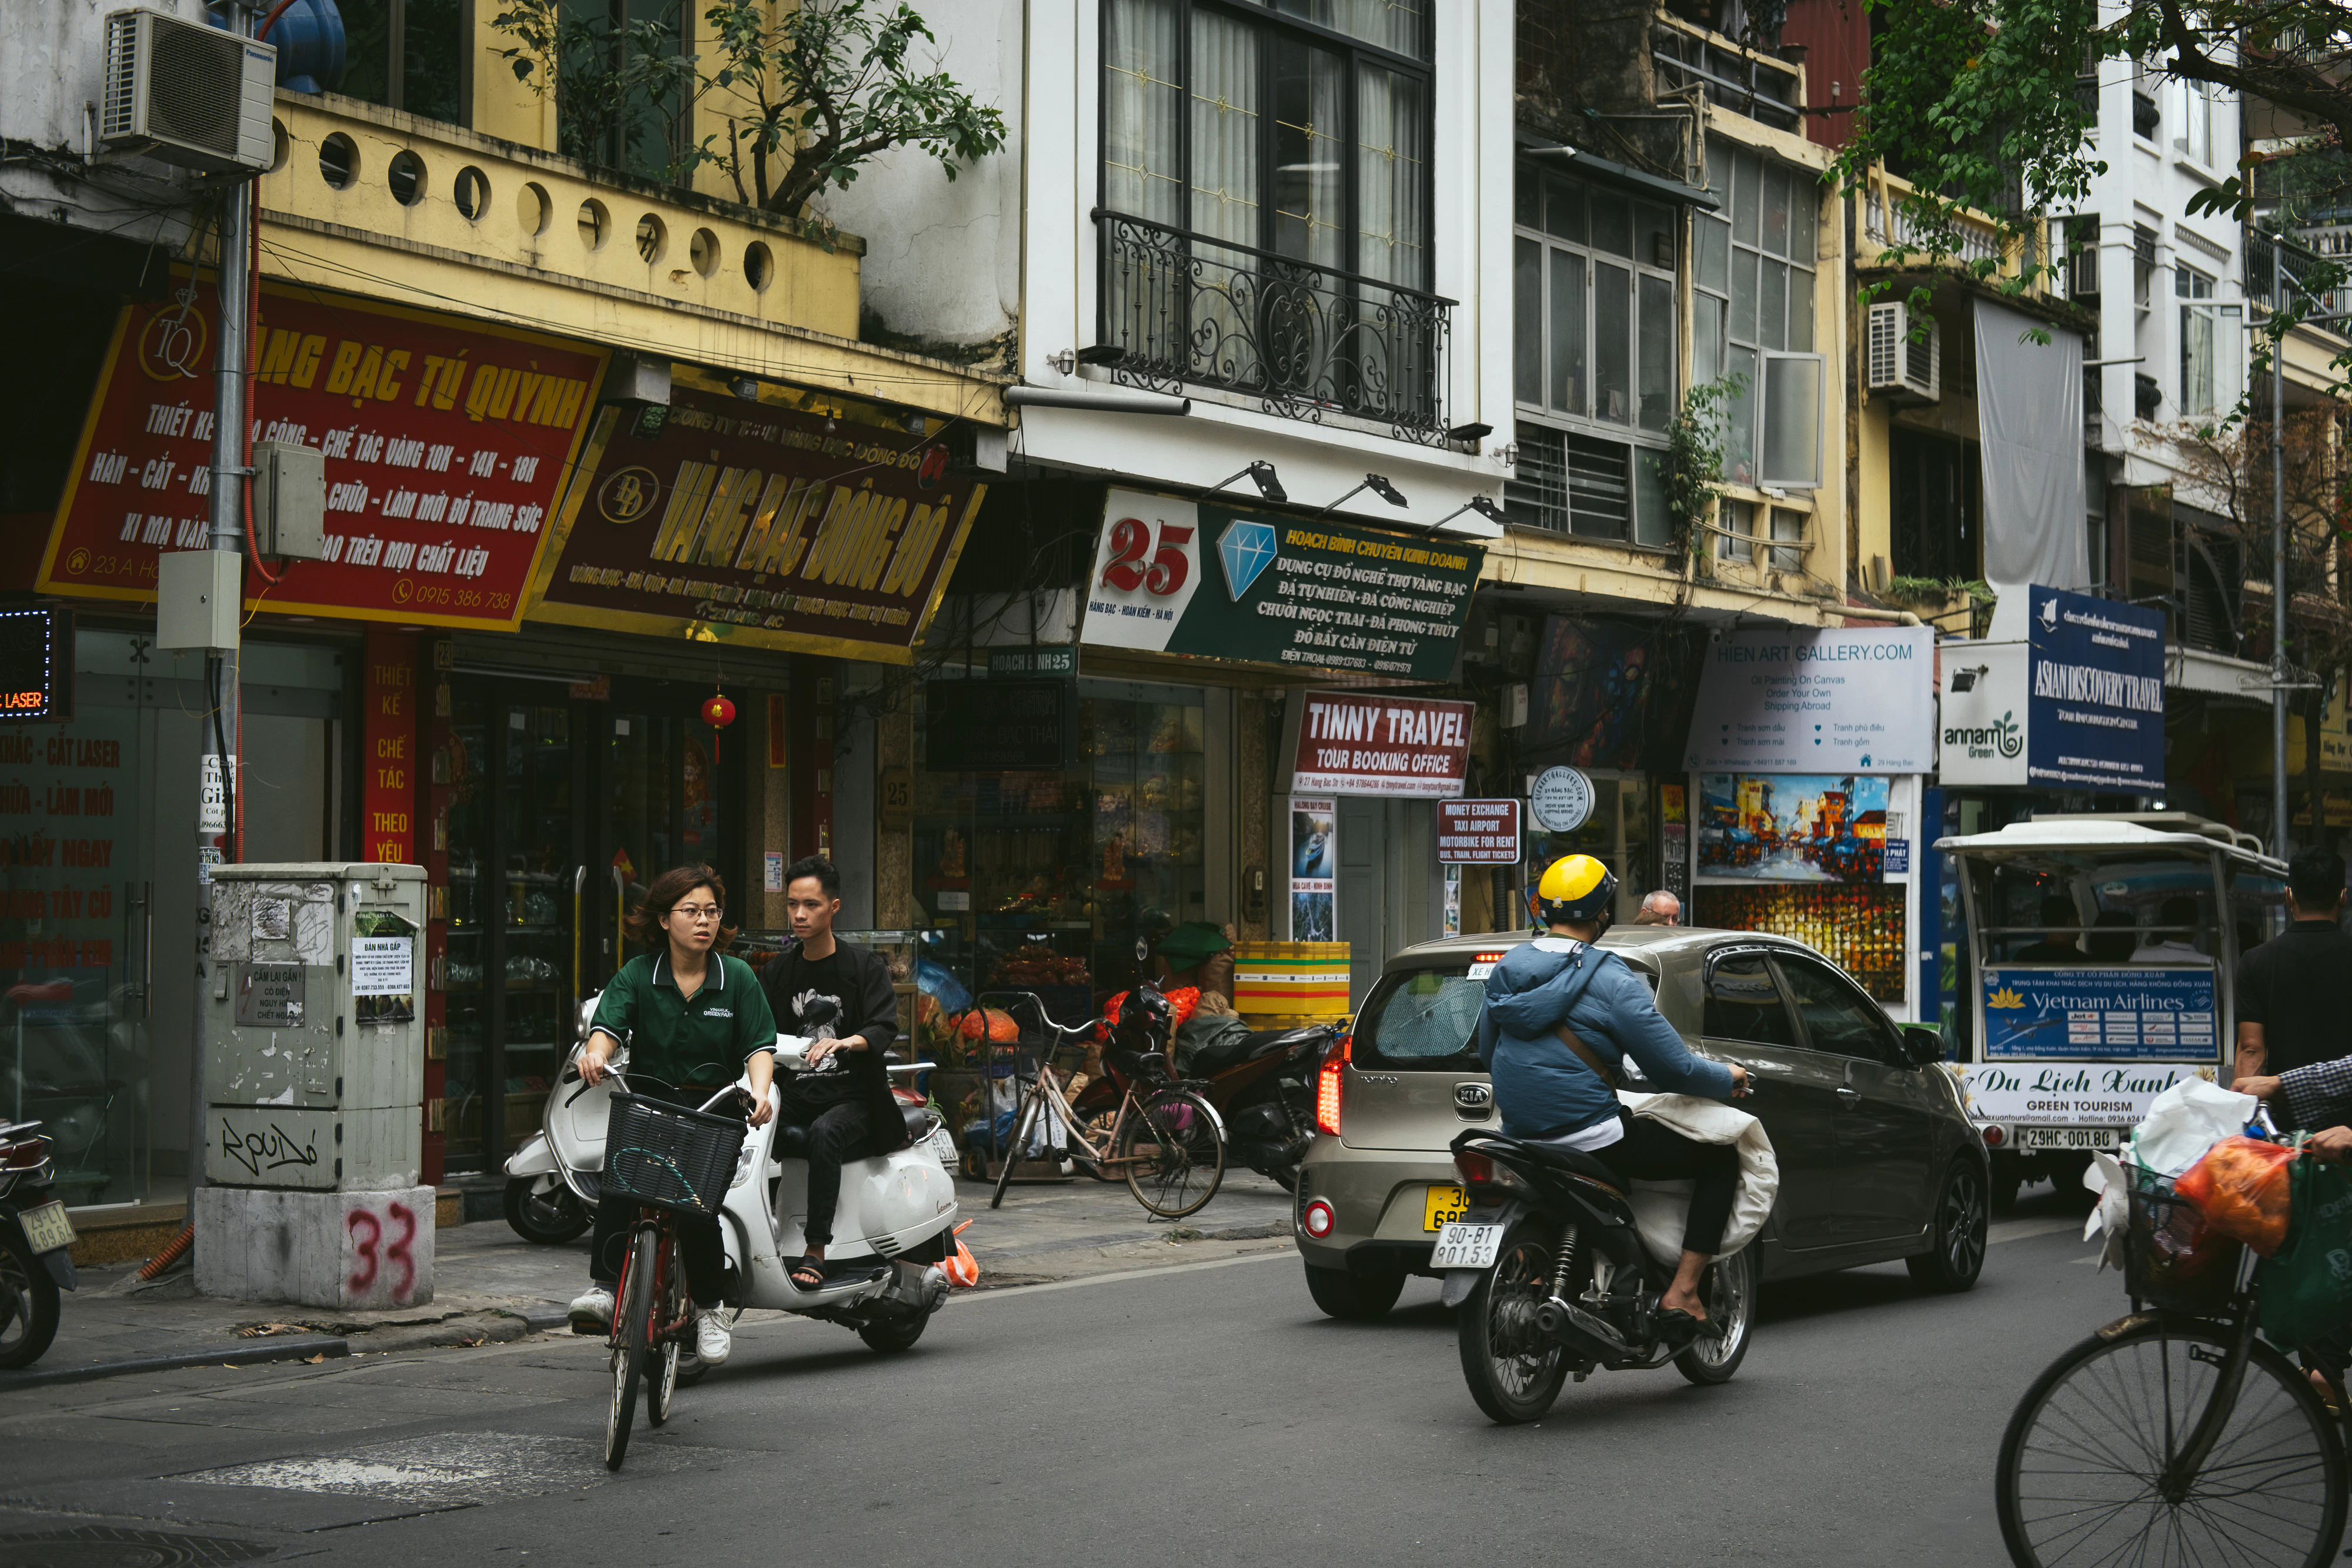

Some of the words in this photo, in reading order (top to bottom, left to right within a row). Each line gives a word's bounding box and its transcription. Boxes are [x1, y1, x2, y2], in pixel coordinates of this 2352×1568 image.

[246, 48, 274, 63] Panasonic
[325, 337, 412, 409] BẠC
[414, 348, 469, 411] TÚ
[464, 360, 587, 429] QUỲNH
[146, 400, 193, 437] THIẾT
[323, 424, 358, 460] CHẾ
[354, 430, 383, 464] TÁC
[385, 433, 425, 469] VÀNG
[425, 444, 454, 473] 10K
[468, 450, 498, 479] 14K
[510, 456, 539, 484] 18K
[89, 449, 128, 484] HÀN
[141, 450, 175, 490] CẮT
[381, 485, 416, 519] LÀM
[469, 500, 514, 530] TRANG
[513, 502, 543, 533] SỨC
[735, 472, 828, 584] BẠC
[119, 512, 143, 542] XI
[141, 515, 172, 550] MẠ
[344, 533, 383, 567] TRÊN
[382, 542, 417, 573] MỌI
[416, 540, 456, 574] CHẤT
[453, 544, 489, 580] LIỆU
[1286, 529, 1328, 551] HOẠCH
[1327, 532, 1356, 554] BÌNH
[1357, 540, 1402, 562] CHUYÊN
[1402, 547, 1430, 565] KINH
[1429, 551, 1468, 570] DOANH
[93, 556, 116, 574] 23
[118, 559, 133, 576] A
[1098, 517, 1195, 597] 25
[1276, 557, 1313, 576] DỤNG
[1314, 563, 1333, 580] CỤ
[1410, 573, 1442, 593] VÀNG
[1443, 581, 1468, 599] BẠC
[416, 586, 450, 606] 0915
[454, 590, 481, 608] 386
[485, 591, 511, 610] 738
[1277, 579, 1298, 596] ĐÁ
[1315, 585, 1357, 604] NHIÊN
[1379, 592, 1411, 611] CÔNG
[1412, 599, 1456, 619] NGHIỆP
[1088, 599, 1105, 613] HÀNG
[1104, 603, 1117, 616] BẠC
[1121, 603, 1137, 617] HOÀN
[1298, 607, 1334, 627] NGỌC
[1335, 611, 1364, 627] TRAI
[1387, 617, 1426, 634] PHONG
[1339, 633, 1365, 650] CÂN
[1366, 636, 1399, 656] ĐIỆN
[1717, 647, 1756, 663] HIEN
[1759, 646, 1790, 663] ART
[1795, 644, 1913, 662] GALLERY.COM
[1052, 654, 1070, 670] 25
[373, 661, 412, 687] THIẾT
[1750, 674, 1763, 686] Oil
[1764, 674, 1798, 688] Painting
[1799, 674, 1812, 685] On
[1813, 674, 1846, 686] Canvas
[1766, 688, 1790, 698] Order
[1791, 688, 1811, 698] Your
[1812, 688, 1832, 698] Own
[2034, 659, 2067, 700] ASIAN
[2067, 665, 2126, 708] DISCOVERY
[2124, 674, 2163, 714] TRAVEL
[5, 691, 42, 708] LASER
[382, 690, 403, 716] KẾ
[1763, 701, 1800, 713] Shipping
[1800, 701, 1831, 711] Abroad
[1308, 703, 1381, 742] TINNY
[1386, 708, 1465, 748] TRAVEL
[1737, 723, 1756, 733] Tranh
[1833, 723, 1854, 733] Tranh
[377, 734, 407, 759] CHẾ
[1736, 737, 1756, 747] Tranh
[1833, 737, 1853, 747] Tranh
[76, 738, 120, 768] LASER
[1317, 748, 1348, 769] TOUR
[1351, 750, 1411, 772] BOOKING
[1411, 753, 1451, 774] OFFICE
[1968, 745, 1994, 759] Green
[377, 765, 405, 790] TÁC
[1304, 776, 1310, 787] 27
[887, 781, 908, 807] 25
[206, 807, 218, 815] Cốt
[1294, 800, 1310, 810] HALONG
[1309, 801, 1318, 810] BAY
[1445, 804, 1471, 816] MONEY
[1471, 804, 1509, 816] EXCHANGE
[373, 812, 407, 833] THEO
[1454, 820, 1468, 832] TAXI
[1470, 820, 1500, 832] AIRPORT
[376, 838, 403, 863] YÊU
[1439, 836, 1479, 848] MOTORBIKE
[1481, 836, 1495, 848] FOR
[1496, 836, 1515, 848] RENT
[62, 838, 113, 868] NGAY
[1439, 850, 1452, 860] BUS,
[1454, 850, 1472, 860] TRAIN,
[1472, 850, 1491, 860] FLIGHT
[1492, 850, 1515, 860] TICKETS
[1890, 847, 1906, 858] PHÁT
[1301, 881, 1311, 891] CAVE
[365, 941, 376, 951] BÁN
[377, 942, 389, 951] NHÀ
[389, 940, 401, 951] GẤP
[253, 967, 269, 982] CẤM
[1472, 968, 1482, 976] XE
[264, 986, 274, 996] CÓ
[259, 999, 278, 1007] NGUY
[2032, 992, 2110, 1009] Vietnam
[2113, 992, 2184, 1010] Airlines
[257, 1009, 275, 1019] CHẾT
[1359, 1075, 1398, 1086] morning
[1978, 1068, 2023, 1093] Du
[2029, 1069, 2093, 1098] Lịch
[1461, 1090, 1484, 1102] KIA
[2026, 1100, 2070, 1112] GREEN
[2074, 1100, 2133, 1112] TOURISM
[2078, 1114, 2106, 1124] Hotline:
[2107, 1115, 2126, 1124] 0936
[2126, 1115, 2141, 1124] 624
[1447, 1226, 1493, 1244] 90-B1
[347, 1201, 419, 1299] 33
[1438, 1246, 1492, 1264] 801.53
